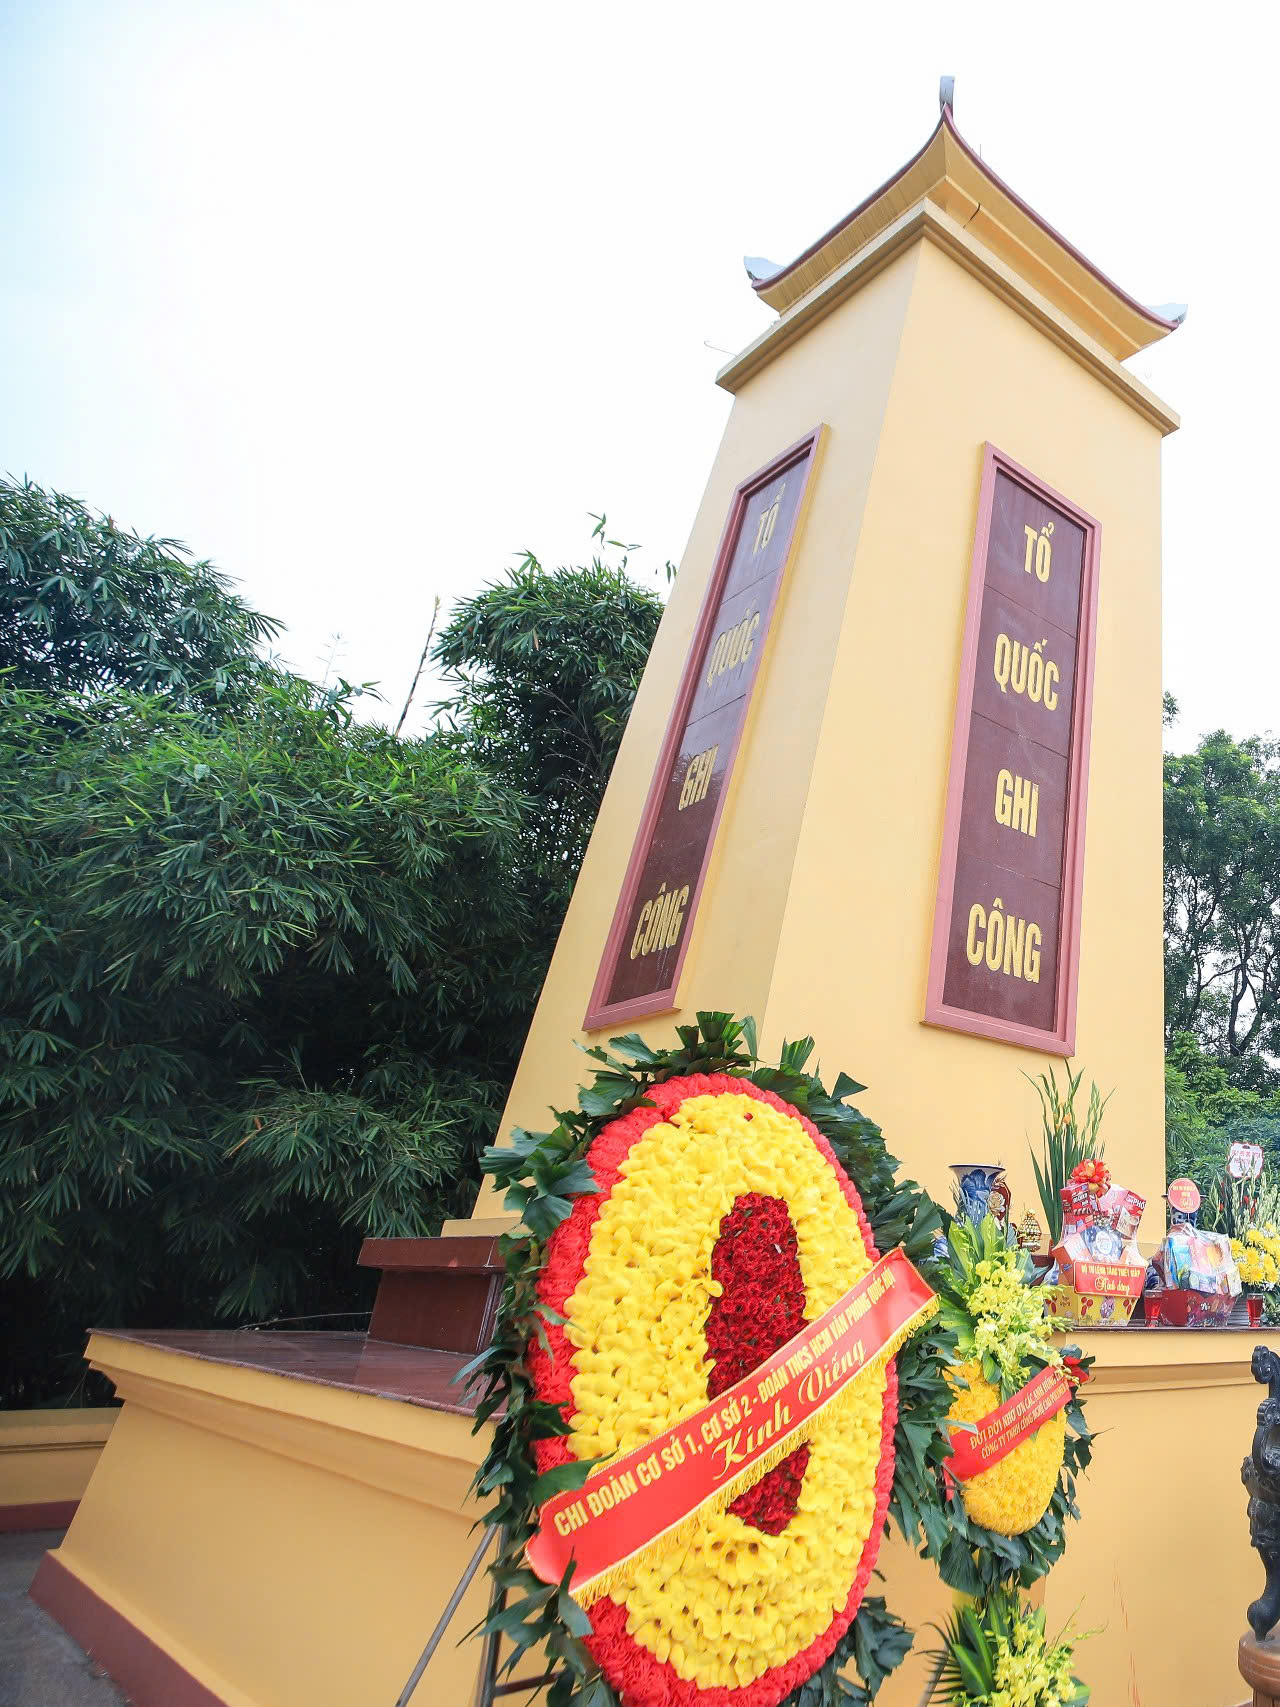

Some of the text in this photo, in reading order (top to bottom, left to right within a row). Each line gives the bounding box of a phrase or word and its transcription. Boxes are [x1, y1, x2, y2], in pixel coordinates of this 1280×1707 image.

[752, 483, 786, 556] TỔ
[1023, 521, 1055, 583] TỔ
[706, 597, 760, 688] QUỐC
[993, 633, 1061, 711] QUỐC
[678, 744, 719, 811] GHI
[995, 769, 1038, 837] GHI
[630, 882, 689, 960] CÔNG
[965, 897, 1042, 983] CÔNG
[553, 1500, 590, 1537] CHI
[586, 1470, 639, 1518] ĐOÀN
[635, 1452, 662, 1487] CƠ
[660, 1434, 686, 1471] SỞ
[684, 1433, 703, 1455] 1,
[701, 1413, 723, 1445] CƠ
[720, 1396, 742, 1430] SỞ
[740, 1395, 753, 1417] 2
[757, 1369, 790, 1404] ĐOÀN
[785, 1345, 814, 1379] TNCS
[808, 1326, 834, 1360] HCM
[828, 1311, 850, 1341] VĂN
[844, 1294, 872, 1328] PHÒNG
[867, 1273, 886, 1305] QUỐC
[880, 1266, 896, 1289] HỘI
[798, 1338, 867, 1405] Viếng
